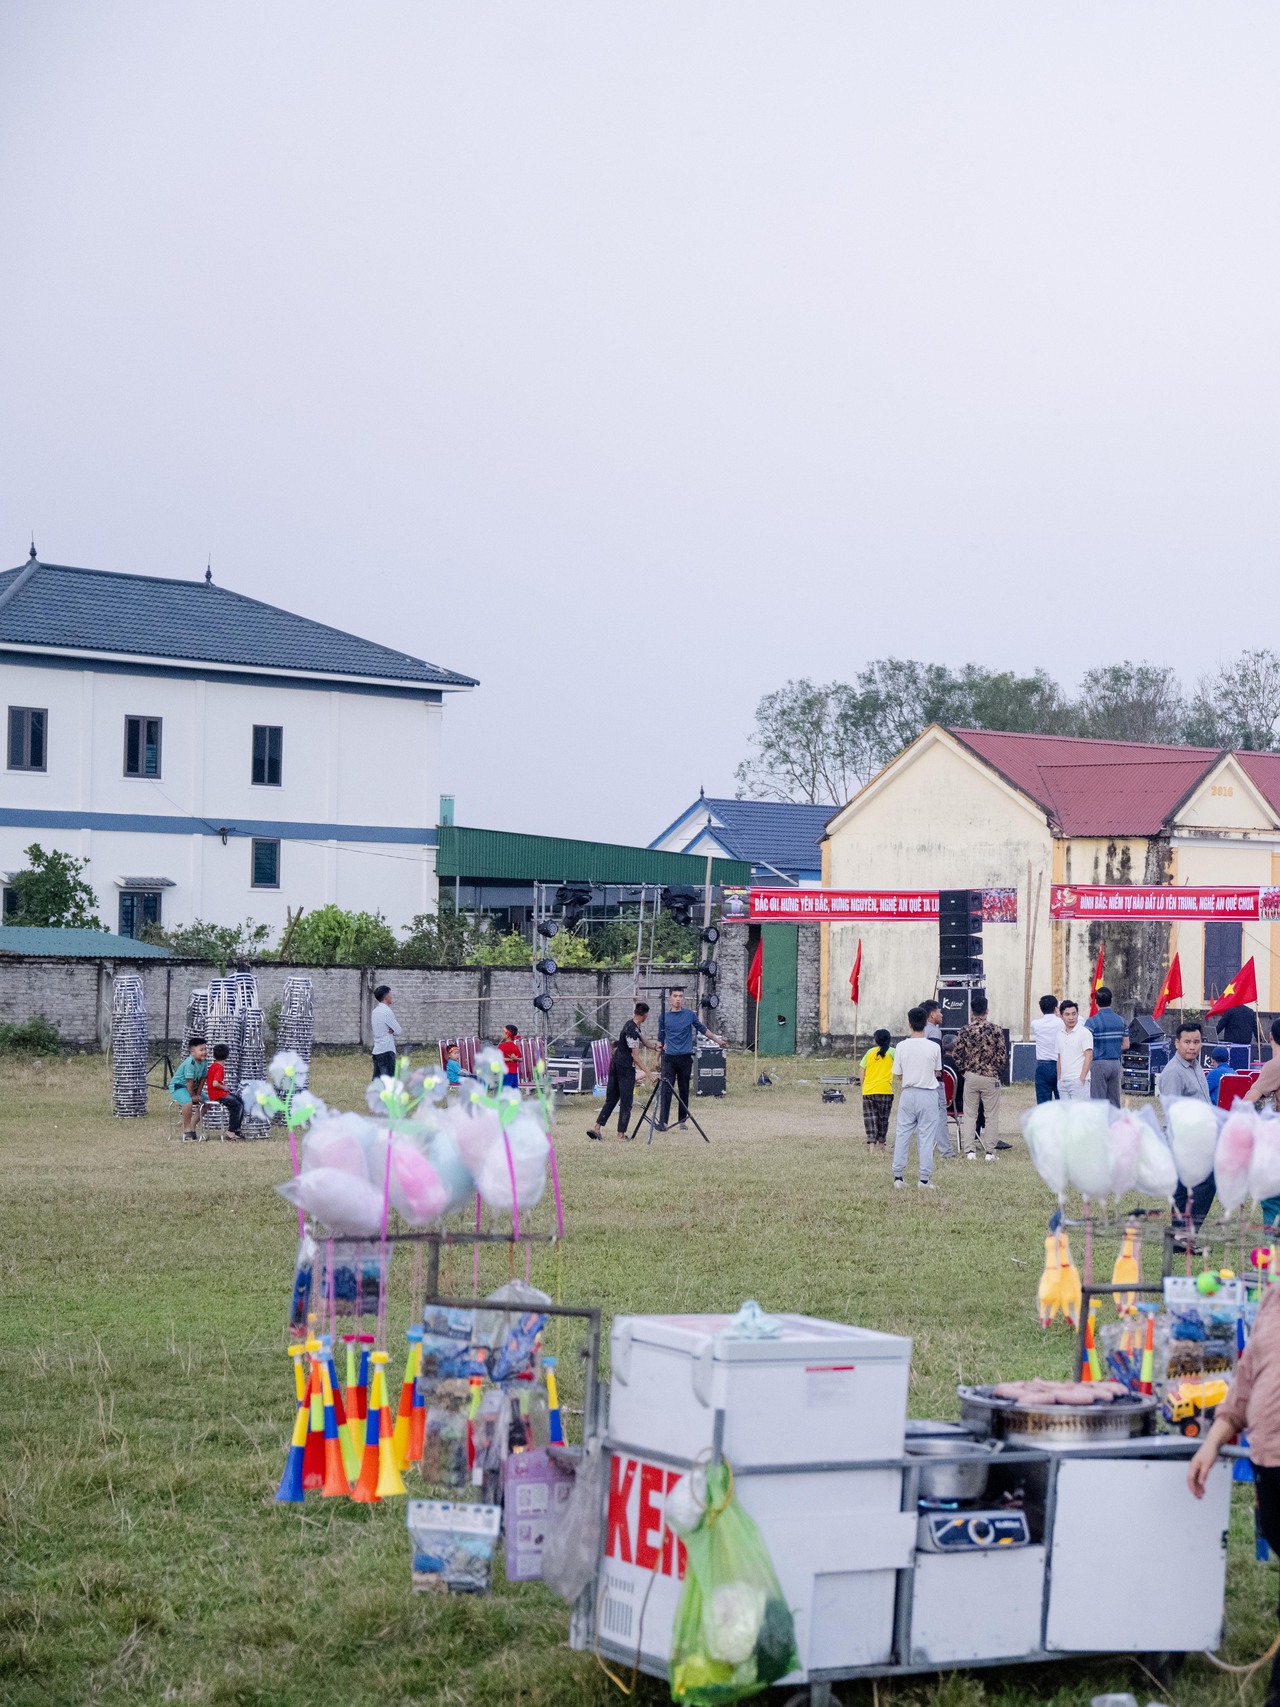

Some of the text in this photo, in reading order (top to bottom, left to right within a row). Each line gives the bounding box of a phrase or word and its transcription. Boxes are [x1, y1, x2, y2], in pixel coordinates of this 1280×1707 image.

[754, 893, 769, 911] BẮC
[780, 896, 799, 911] HƯNG
[800, 895, 813, 911] YÊN
[814, 893, 830, 913] BẮC,
[831, 897, 849, 911] HƯNG
[850, 896, 878, 913] NGUYÊN,
[879, 896, 897, 914] NGHỆ
[898, 899, 908, 912] AN
[909, 896, 922, 913] QUÊ
[923, 899, 931, 912] TA
[1080, 893, 1094, 909] ĐÌNH
[1124, 895, 1133, 912] TỰ
[1133, 893, 1144, 910] HÀO
[1145, 892, 1156, 909] ĐẤT
[1165, 894, 1177, 909] YÊN
[1178, 896, 1198, 912] TRUNG,
[1199, 894, 1215, 913] NGHỆ
[1215, 897, 1225, 910] AN
[1225, 894, 1238, 911] QUÊ
[1238, 897, 1254, 910] CHOA
